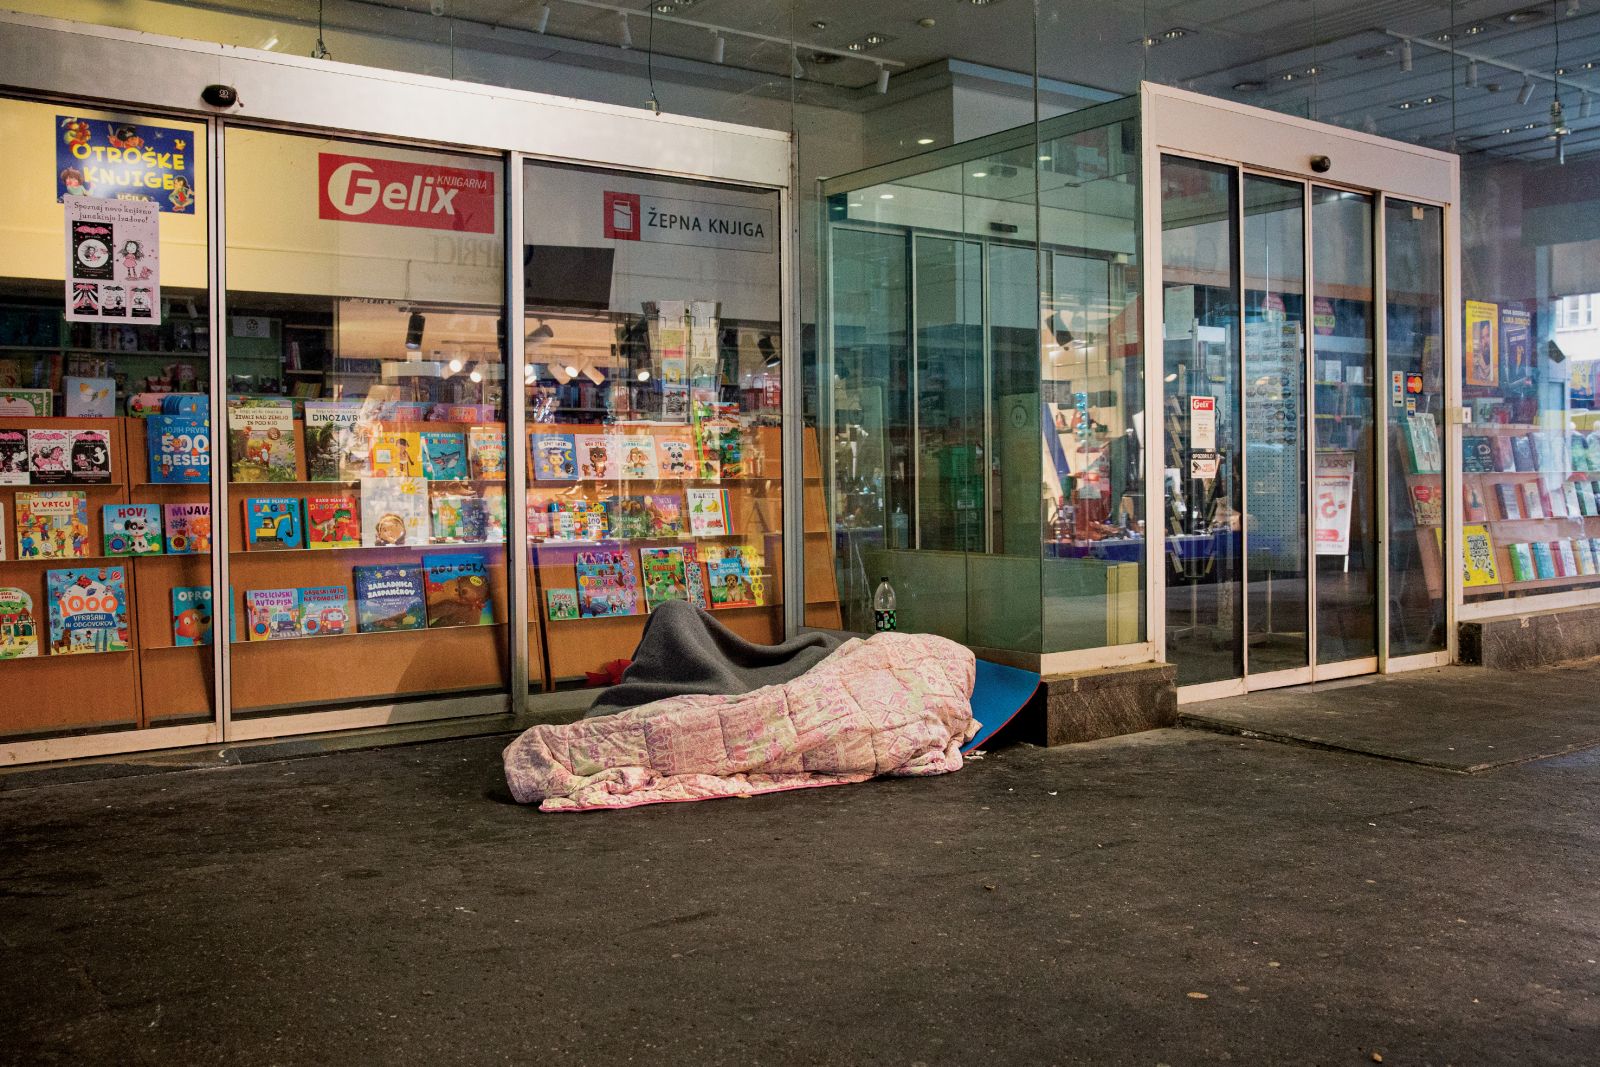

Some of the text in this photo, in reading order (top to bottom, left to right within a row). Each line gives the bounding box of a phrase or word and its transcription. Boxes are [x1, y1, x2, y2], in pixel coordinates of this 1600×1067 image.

[72, 143, 185, 171] OTROŠKE
[83, 166, 175, 190] KNJIGE
[436, 174, 488, 190] KNJIGARNA
[327, 162, 459, 216] Felix
[647, 207, 765, 238] ŽEPNA KNJIGA
[312, 414, 361, 422] DINOZAVRI
[161, 434, 209, 453] 500
[162, 454, 210, 466] BESED
[118, 508, 147, 518] HOV!
[172, 505, 211, 516] MIJAV!
[253, 504, 295, 512] BAGER
[367, 581, 413, 590] ZAKLADNICA
[254, 591, 293, 599] POLICIJSKI
[367, 588, 415, 599] ZASPANČKOV
[58, 595, 119, 617] 1000
